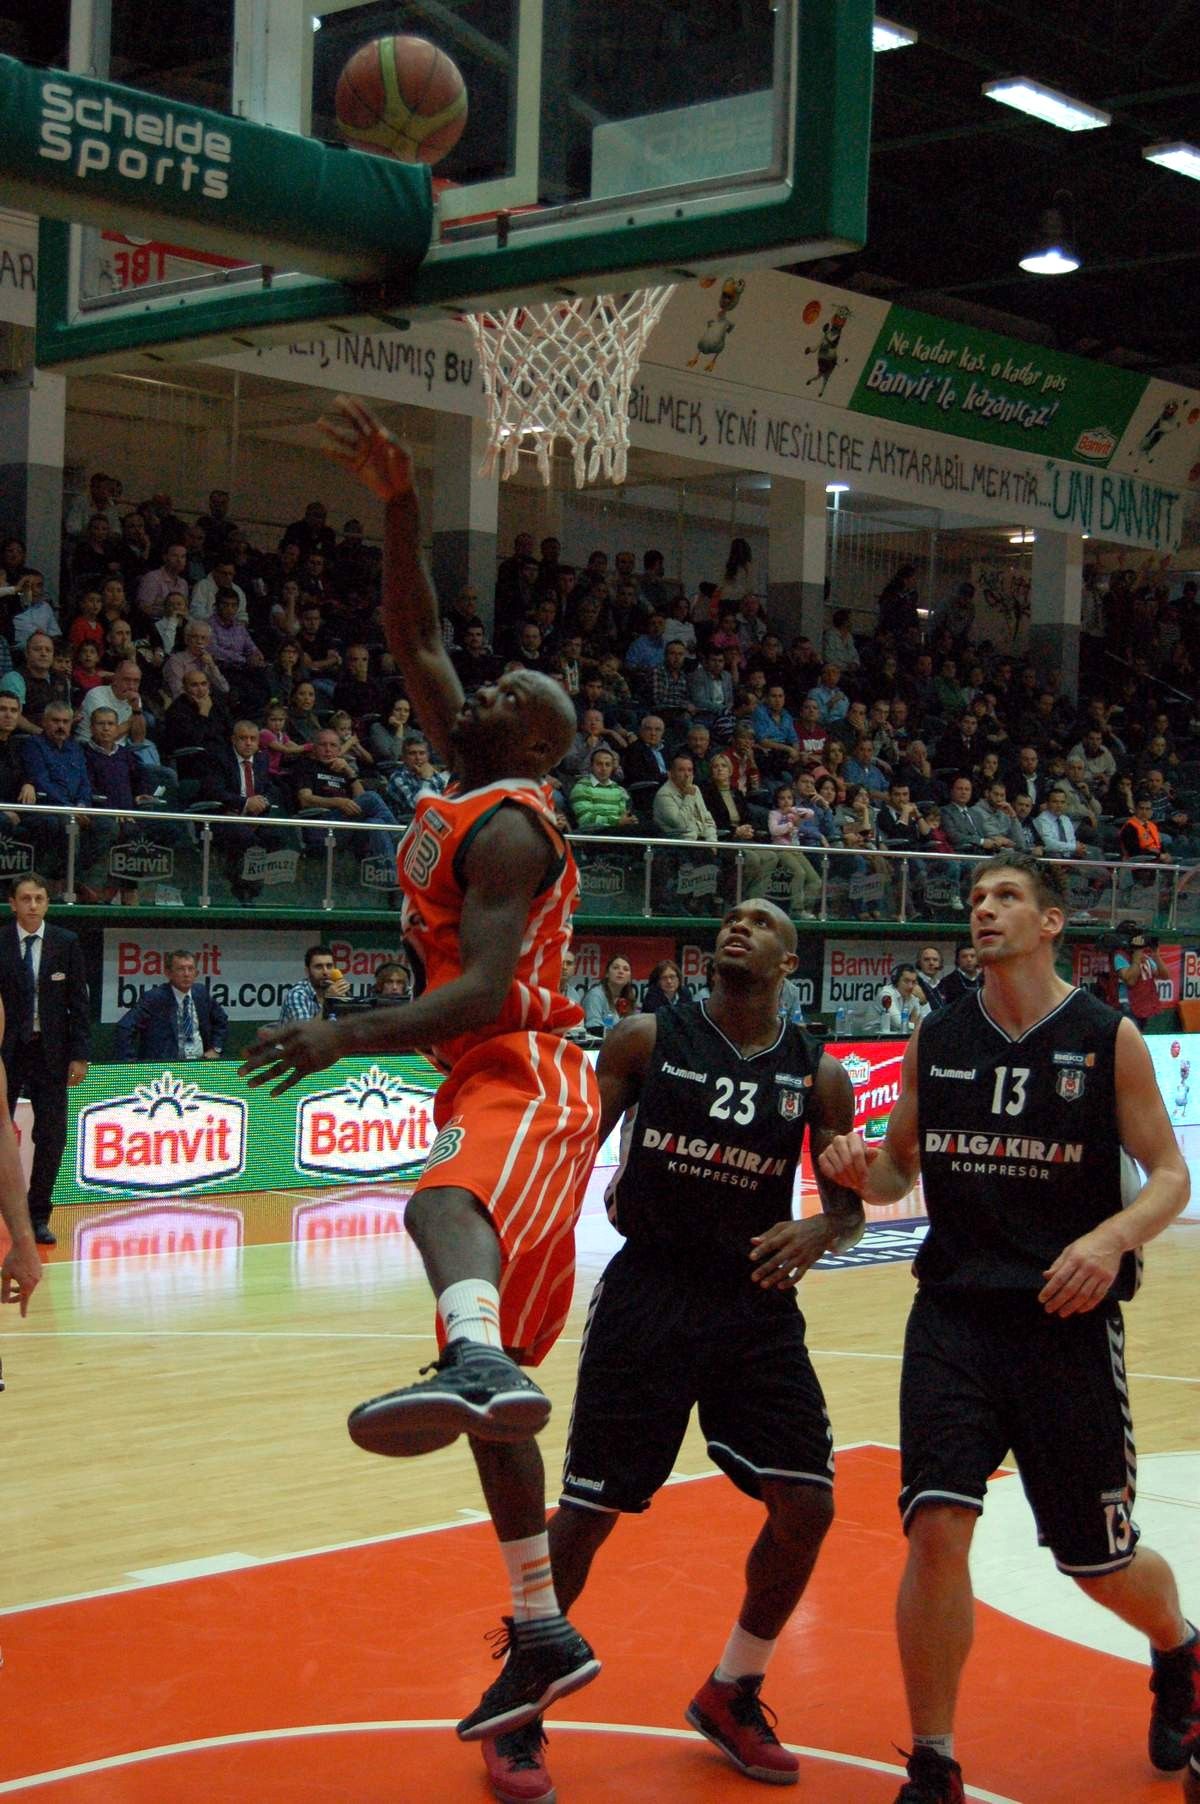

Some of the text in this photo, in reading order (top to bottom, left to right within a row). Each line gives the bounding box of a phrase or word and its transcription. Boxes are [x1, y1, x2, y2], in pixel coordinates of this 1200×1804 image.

[42, 83, 232, 163] Schelde
[39, 122, 229, 200] Sports
[887, 330, 909, 357] Ne
[912, 336, 957, 365] kadar
[991, 362, 1001, 377] o
[1002, 358, 1042, 386] kadar
[445, 352, 473, 385] BU
[715, 409, 757, 448] YENİ
[766, 418, 864, 473] NESİLLERE
[114, 852, 169, 873] Banvit
[831, 951, 896, 976] Banvit
[661, 1061, 707, 1084] hummel
[930, 1065, 976, 1080] hummel
[991, 1066, 1031, 1116] 13
[709, 1077, 759, 1125] 23
[94, 1115, 231, 1169] Banvit
[311, 1106, 431, 1155] Banvit
[642, 1128, 787, 1177] DALGAKIRAN
[925, 1132, 1083, 1163] DALGAKIRAN
[668, 1160, 758, 1191] KOMPRESÖR
[952, 1161, 1049, 1180] KOMPRESÖR
[1104, 1503, 1131, 1554] 13
